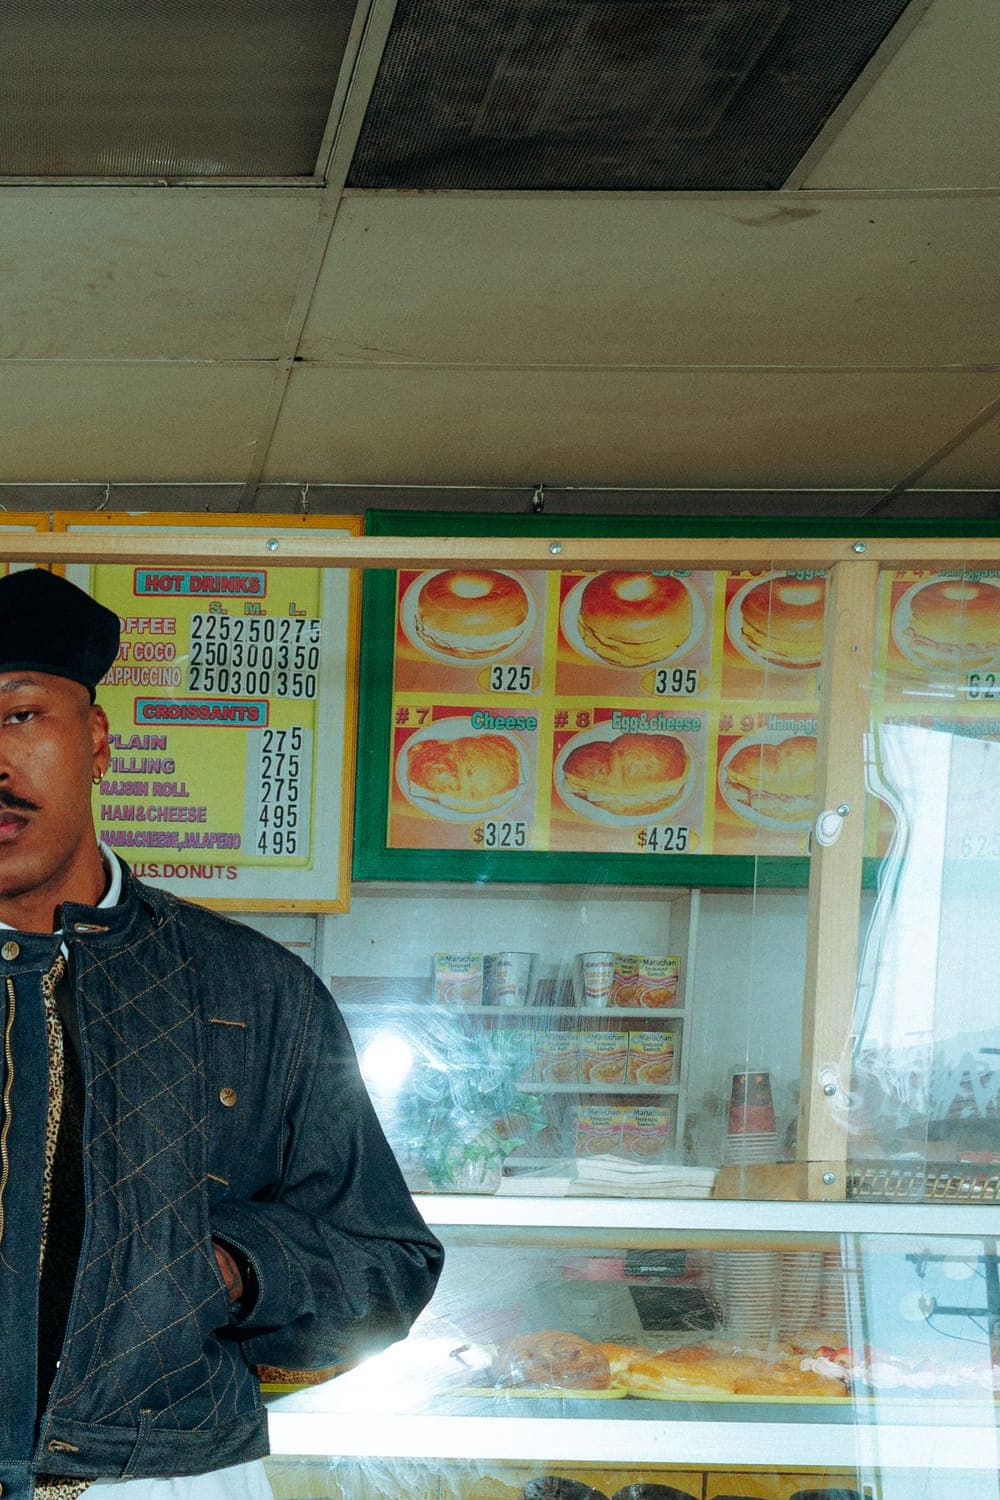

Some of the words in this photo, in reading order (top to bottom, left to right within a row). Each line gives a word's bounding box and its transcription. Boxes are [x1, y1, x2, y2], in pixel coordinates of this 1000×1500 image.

[145, 575, 184, 591] HOT
[189, 576, 260, 593] DRINKS
[133, 642, 176, 661] COCO
[143, 704, 260, 721] CROISSANTS
[471, 711, 537, 731] Cheese
[611, 711, 701, 734] Egg&cheese
[262, 727, 302, 753] 275
[110, 757, 175, 774] ILLING
[261, 753, 299, 779] 275
[153, 781, 190, 797] ROLL
[261, 779, 298, 803] 275
[101, 804, 207, 823] HAM&CHEESE
[259, 804, 297, 828] 495
[258, 831, 296, 855] 495
